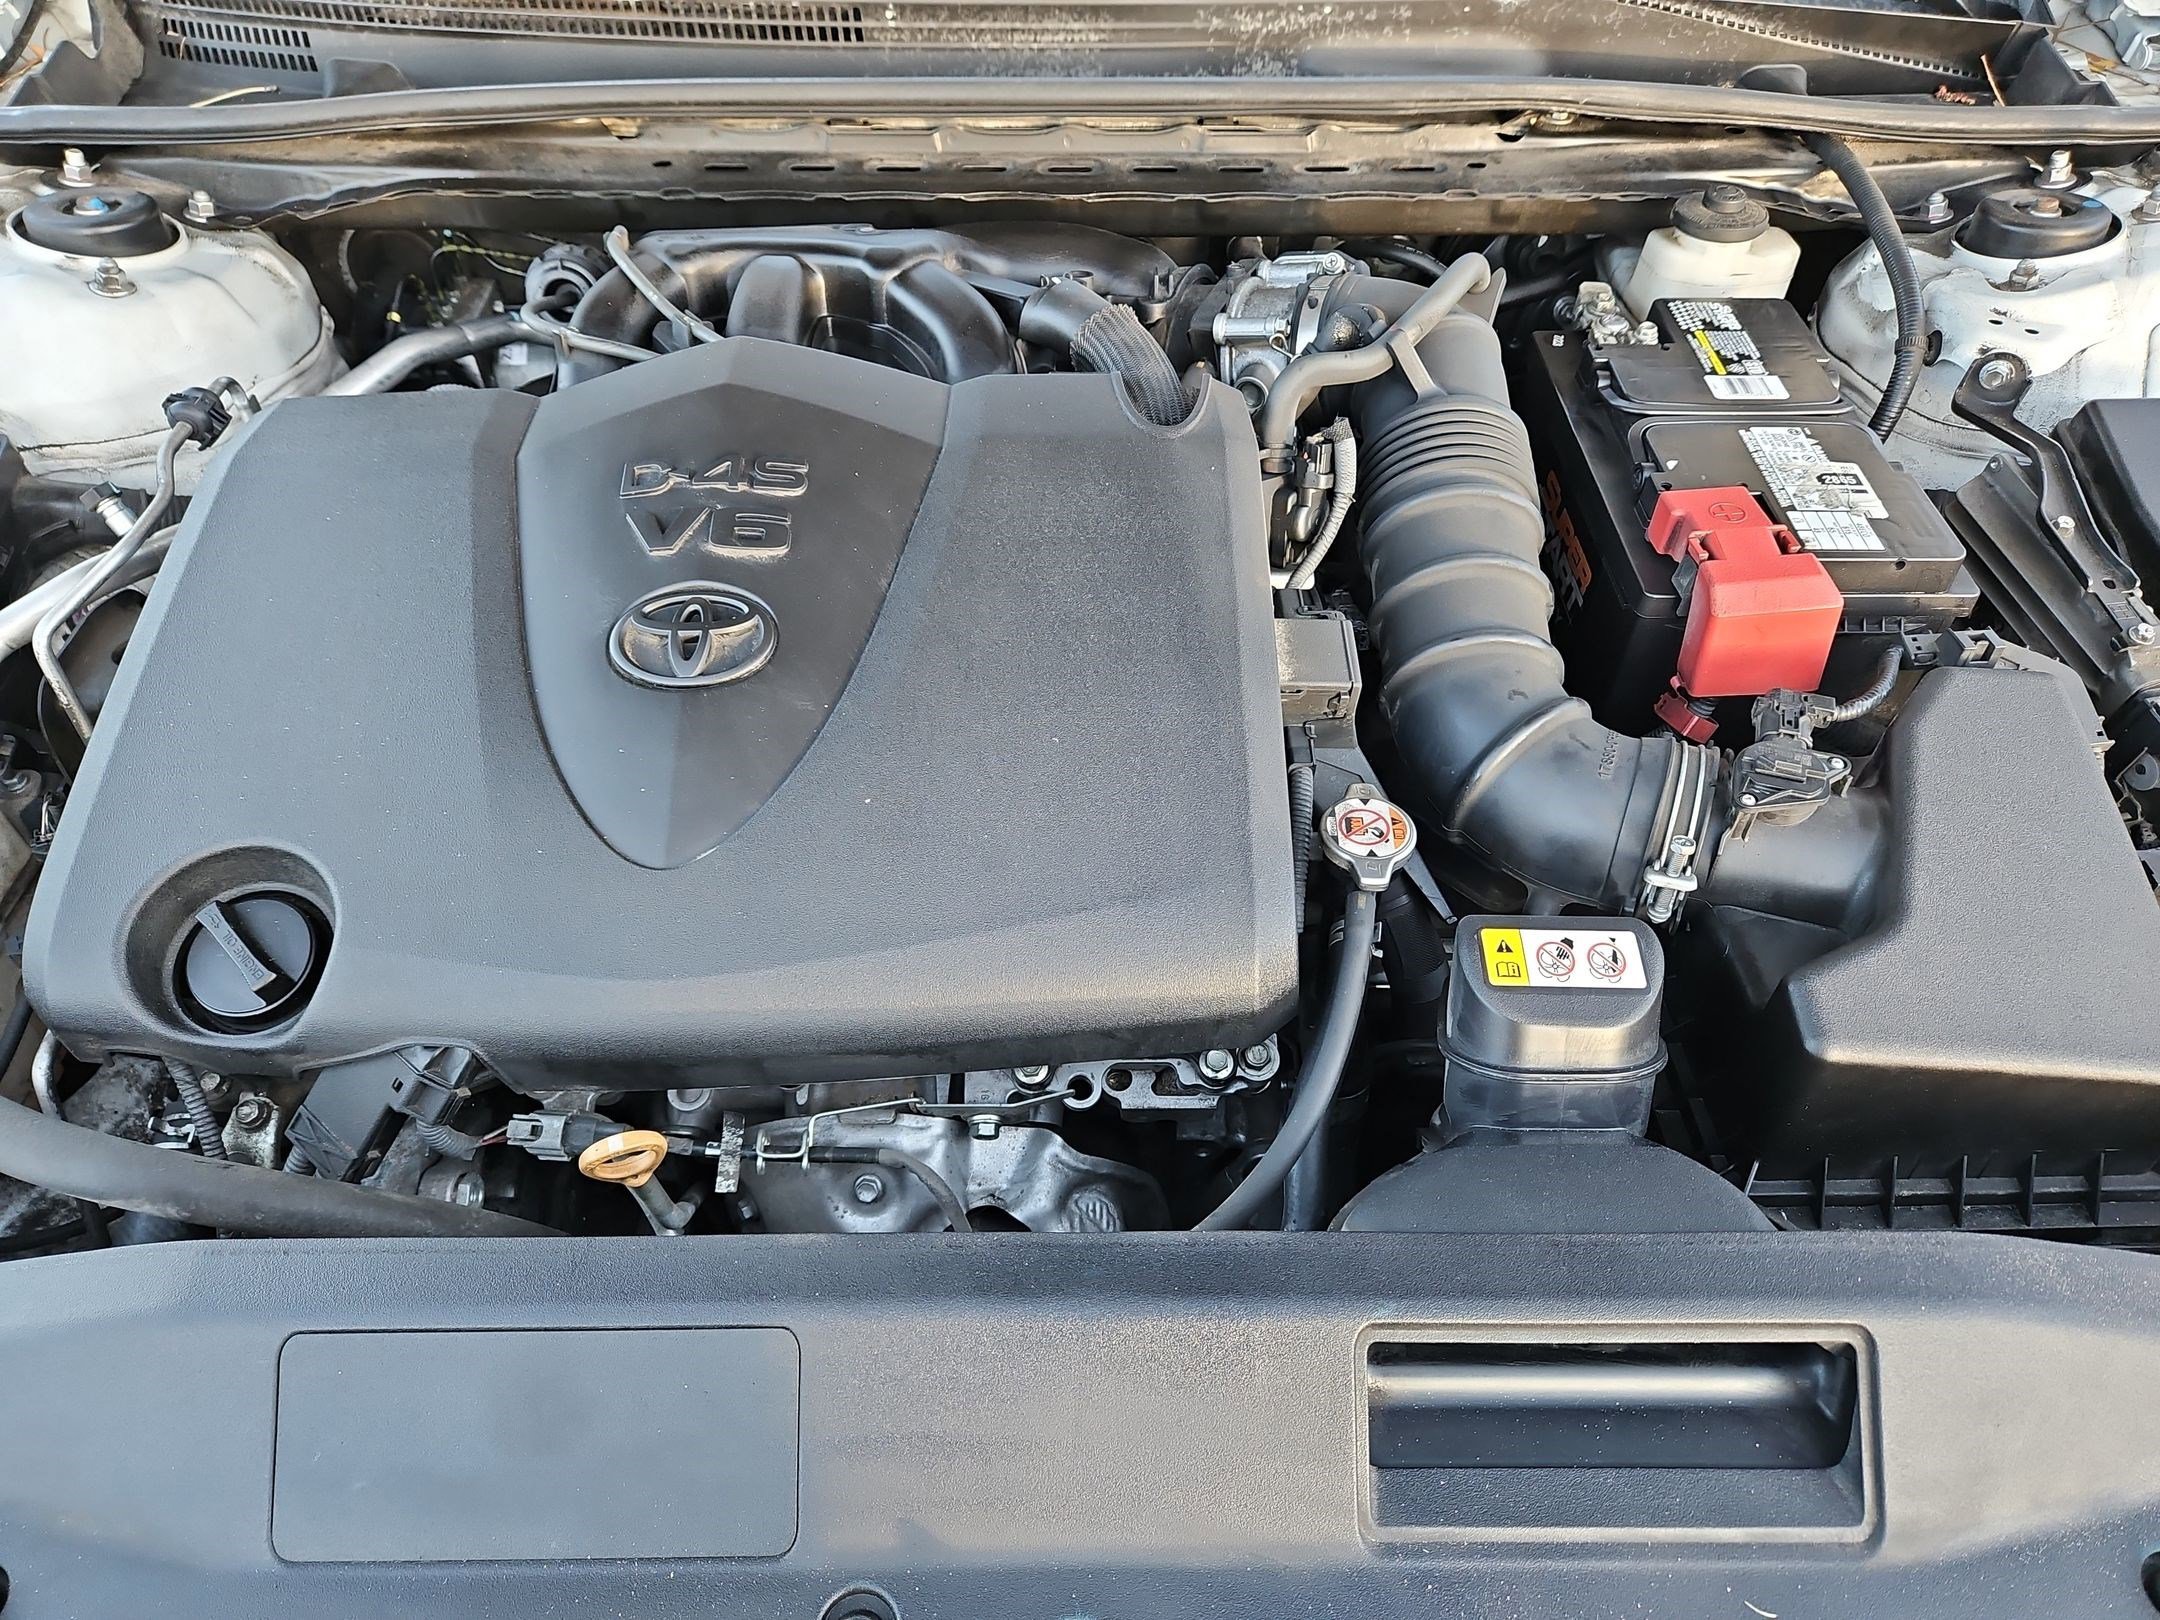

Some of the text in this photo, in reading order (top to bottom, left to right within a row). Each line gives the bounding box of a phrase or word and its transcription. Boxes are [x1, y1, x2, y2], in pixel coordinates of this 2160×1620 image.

[619, 455, 810, 499] D-4S
[625, 506, 793, 555] V6
[222, 929, 265, 980] ENGINE OIL
